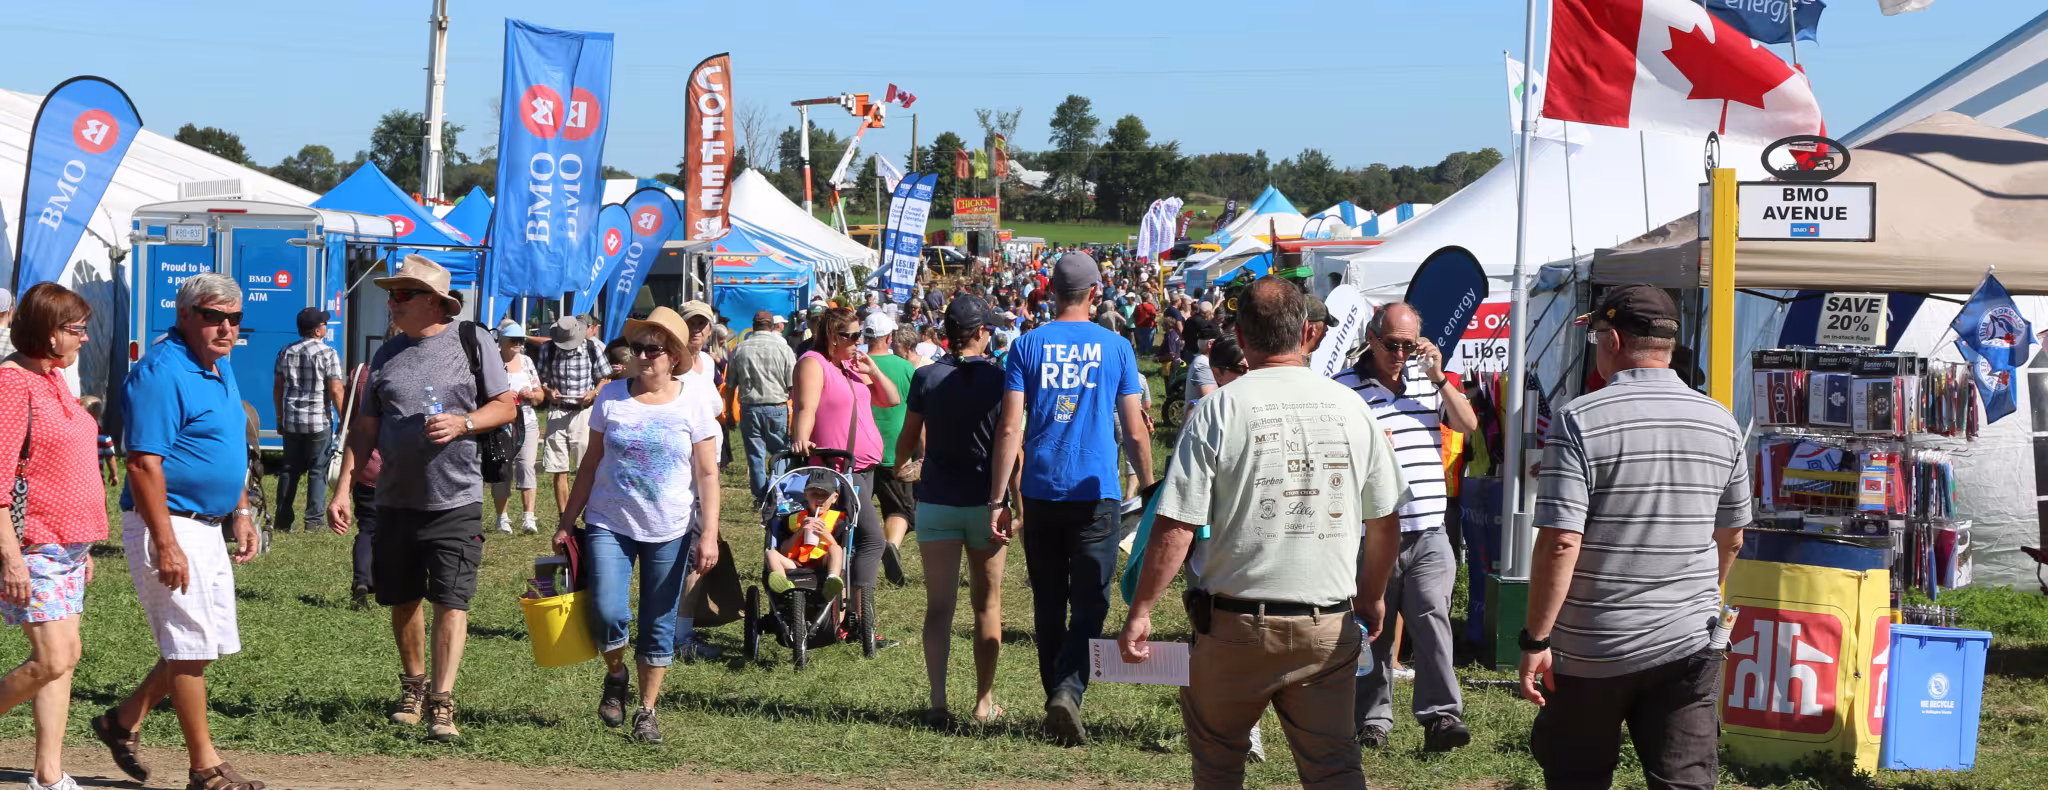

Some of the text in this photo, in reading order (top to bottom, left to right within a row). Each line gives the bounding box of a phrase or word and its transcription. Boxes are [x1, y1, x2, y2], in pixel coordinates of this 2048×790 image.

[1725, 0, 1789, 24] energy
[695, 65, 727, 211] COFFEE
[38, 159, 86, 232] BMO
[526, 152, 555, 246] BMO
[1782, 188, 1829, 202] BMO
[956, 199, 991, 210] CHICKEN
[1762, 206, 1848, 221] AVENUE
[161, 262, 211, 273] Proud to be
[616, 242, 643, 295] BMO
[895, 259, 916, 269] LESLIE
[167, 276, 173, 284] a
[248, 275, 272, 283] BMO
[248, 292, 268, 302] ATM
[1444, 287, 1477, 336] energy
[1826, 296, 1881, 314] SAVE
[1826, 314, 1870, 332] 20%
[1855, 334, 1871, 342] flags
[1042, 343, 1102, 363] TEAM
[1763, 354, 1780, 363] Banner
[1818, 356, 1838, 364] Banner
[1863, 360, 1883, 368] Banner
[1041, 361, 1100, 389] RBC
[1261, 417, 1283, 425] Home
[1285, 439, 1302, 452] SCL
[1285, 501, 1316, 518] Lilly
[1284, 522, 1305, 530] Bayer
[1929, 700, 1955, 709] RECYCLE
